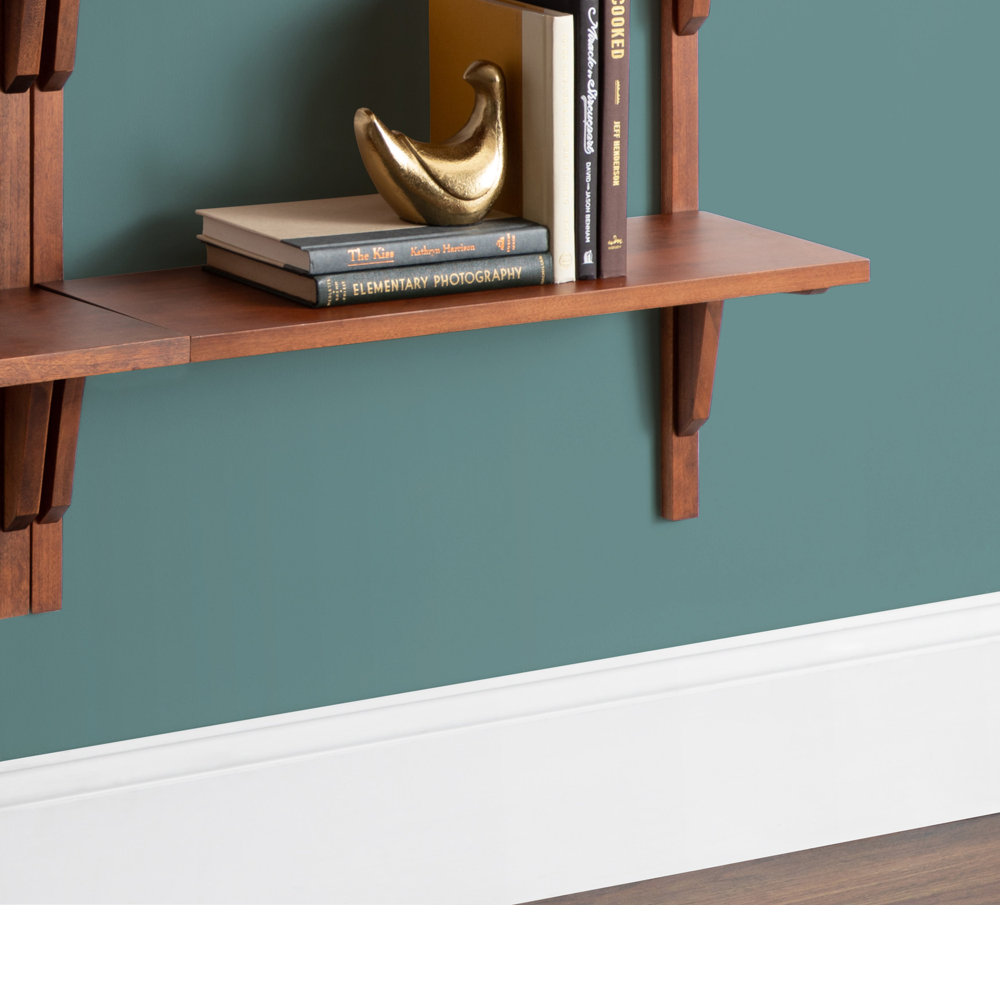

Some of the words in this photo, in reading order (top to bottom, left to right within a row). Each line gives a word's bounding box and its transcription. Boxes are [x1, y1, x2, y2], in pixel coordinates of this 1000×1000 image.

[612, 140, 620, 186] HENDERSON
[347, 247, 369, 262] The
[372, 246, 395, 260] Kiss
[410, 245, 441, 257] Kathryn
[442, 243, 475, 254] Harrison
[352, 276, 428, 296] ELEMENTARY
[433, 266, 522, 288] PHOTOGRAPHY
